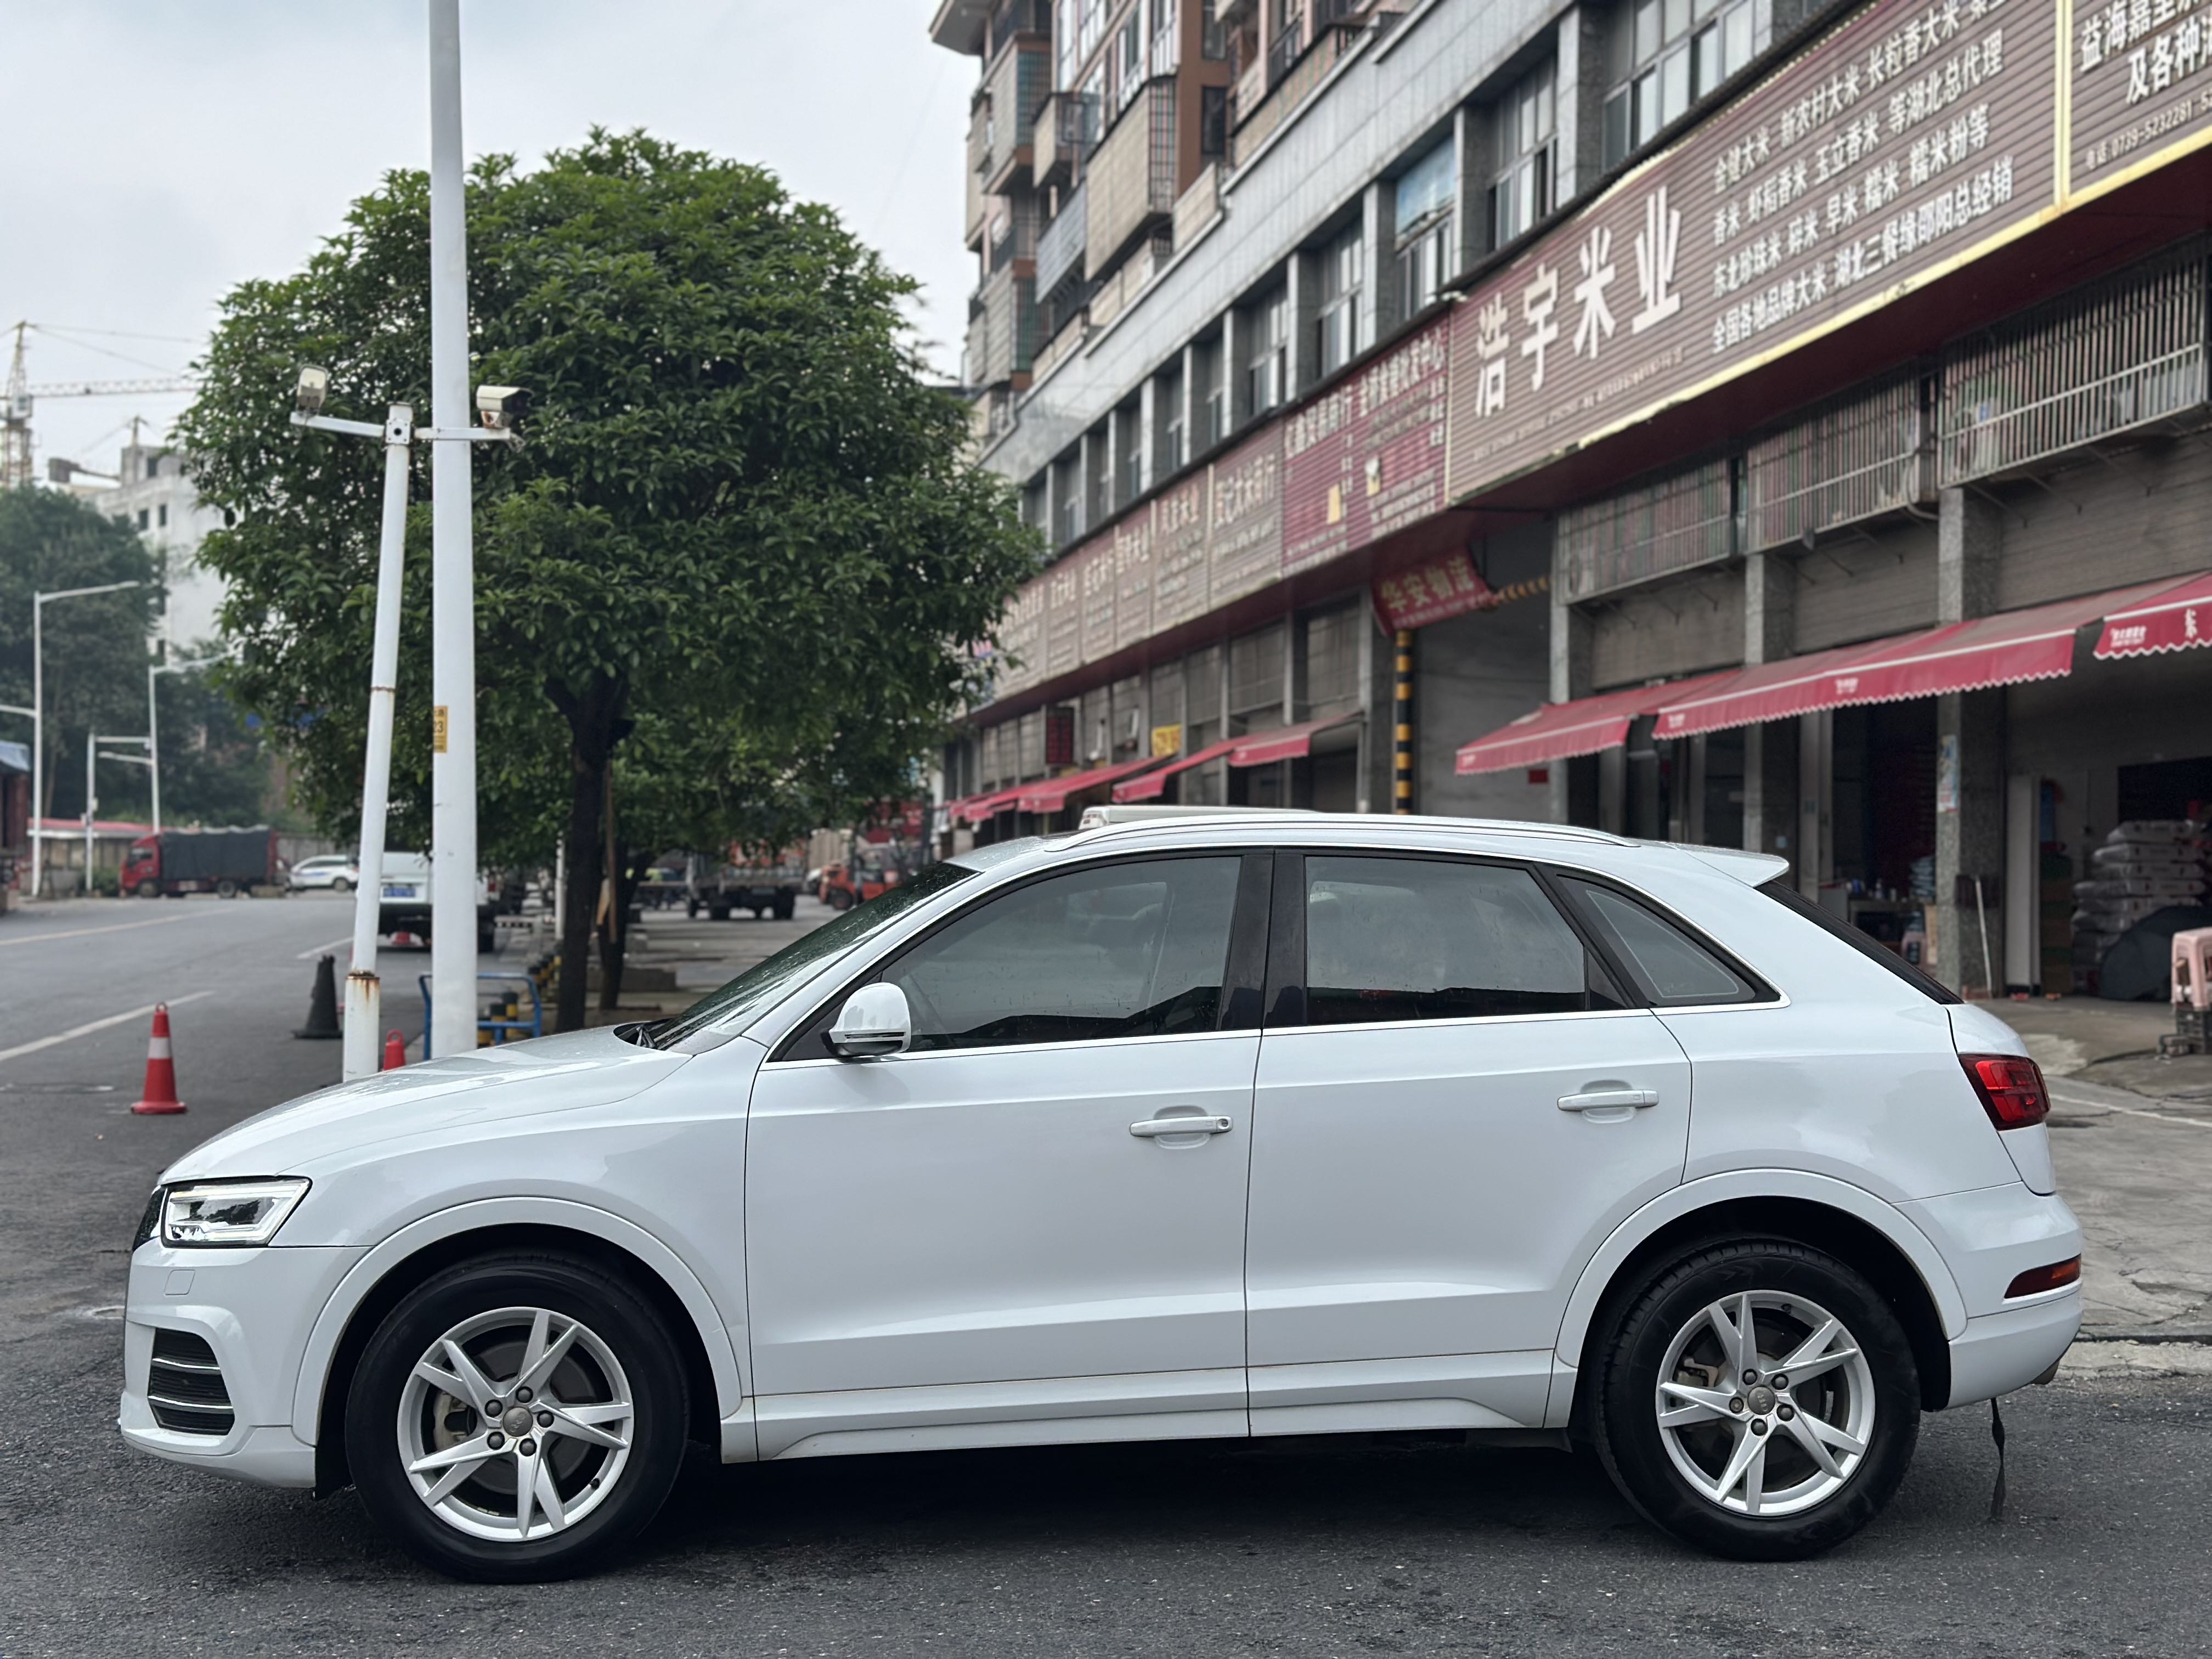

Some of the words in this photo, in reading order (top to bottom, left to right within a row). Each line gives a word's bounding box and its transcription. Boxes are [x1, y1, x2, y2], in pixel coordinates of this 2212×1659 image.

[1867, 0, 1960, 91] 长粒香大米
[2080, 0, 2194, 72] 益海嘉
[1713, 231, 1782, 298] 东北珍珠米
[1826, 185, 1858, 234] 早米
[1864, 159, 1900, 214] 糯米
[1909, 103, 1990, 188] 糯米粉等
[1714, 201, 1740, 246] 香米
[1888, 28, 2003, 134] 等湖北总代理
[1475, 185, 1682, 417] 浩宇米业
[1712, 261, 1827, 354] 全国各地品牌大米
